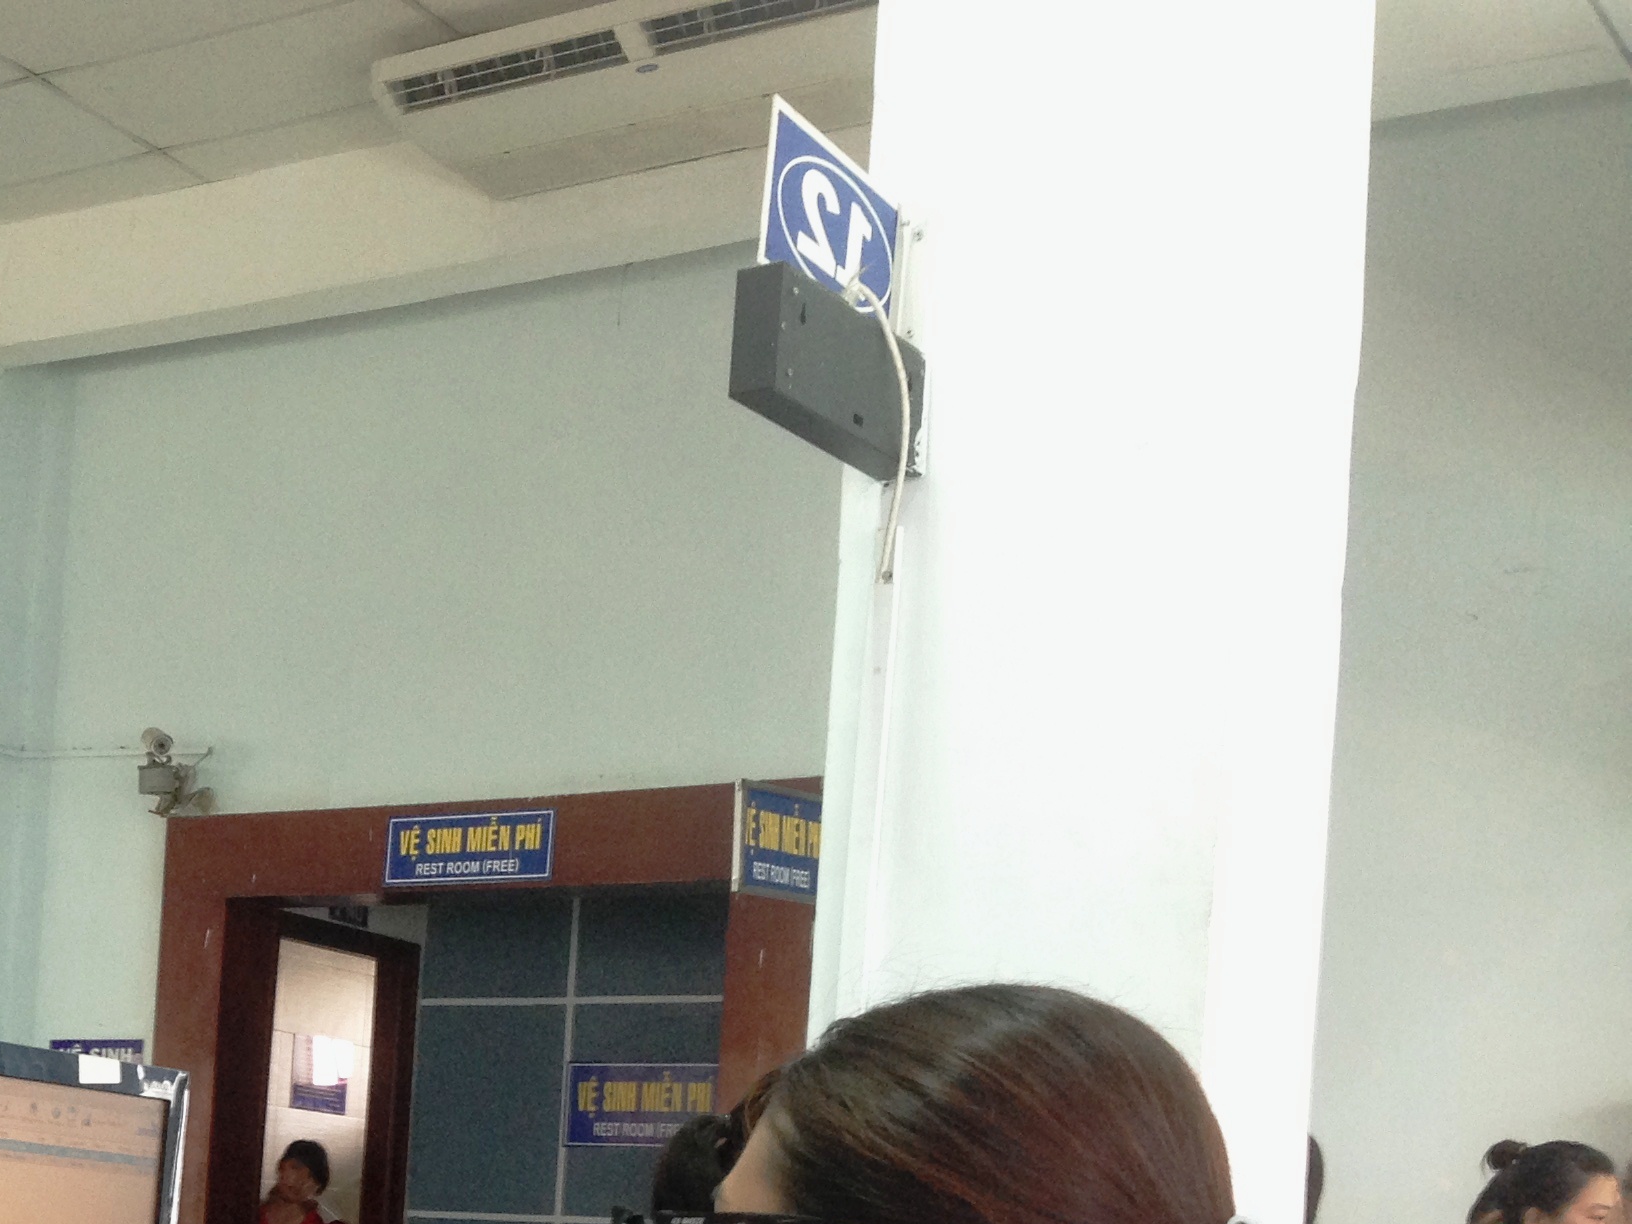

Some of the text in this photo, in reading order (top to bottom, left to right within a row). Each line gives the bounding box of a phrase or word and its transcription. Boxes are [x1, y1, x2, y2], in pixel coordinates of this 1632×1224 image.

[400, 816, 542, 860] VỆ SINH MIỄN PHÍ
[415, 858, 519, 875] REST ROOM (FREE)
[578, 1075, 599, 1119] VỆ
[603, 1081, 637, 1112] SINH
[593, 1122, 622, 1137] REST
[623, 1122, 656, 1137] ROOM
